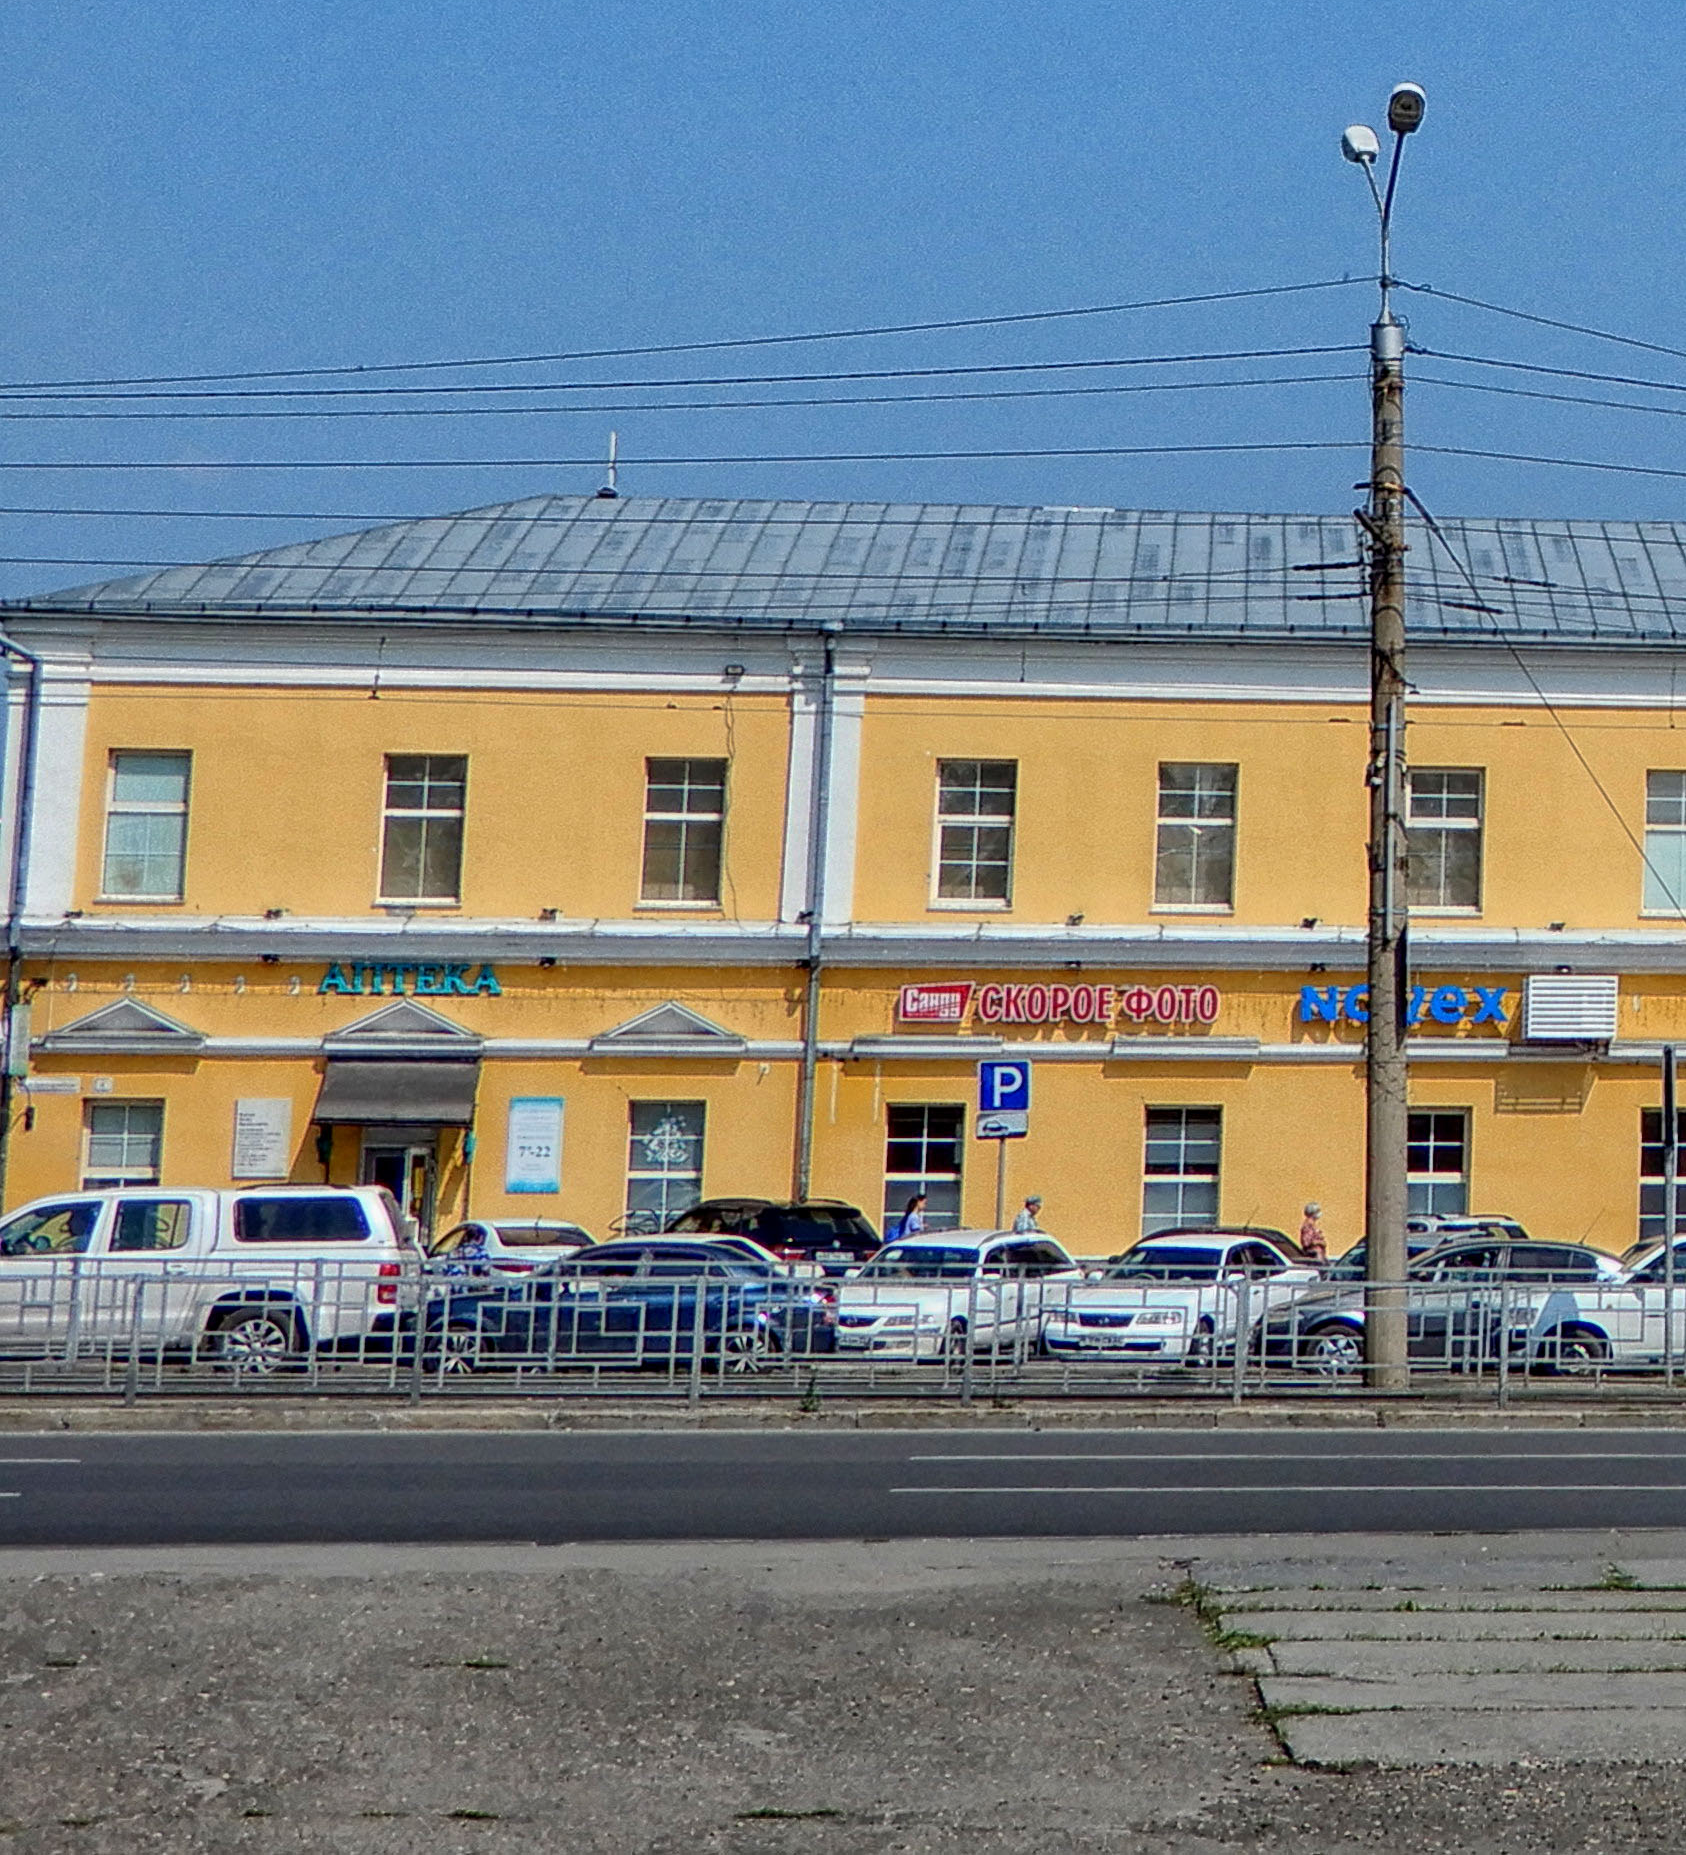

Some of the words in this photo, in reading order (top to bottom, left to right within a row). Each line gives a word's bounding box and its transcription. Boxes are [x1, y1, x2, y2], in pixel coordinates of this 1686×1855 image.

[317, 961, 502, 995] АПТЕКА
[979, 984, 1115, 1022] СКОРОЕ
[1123, 984, 1220, 1022] ФОТО
[993, 1066, 1023, 1107] P
